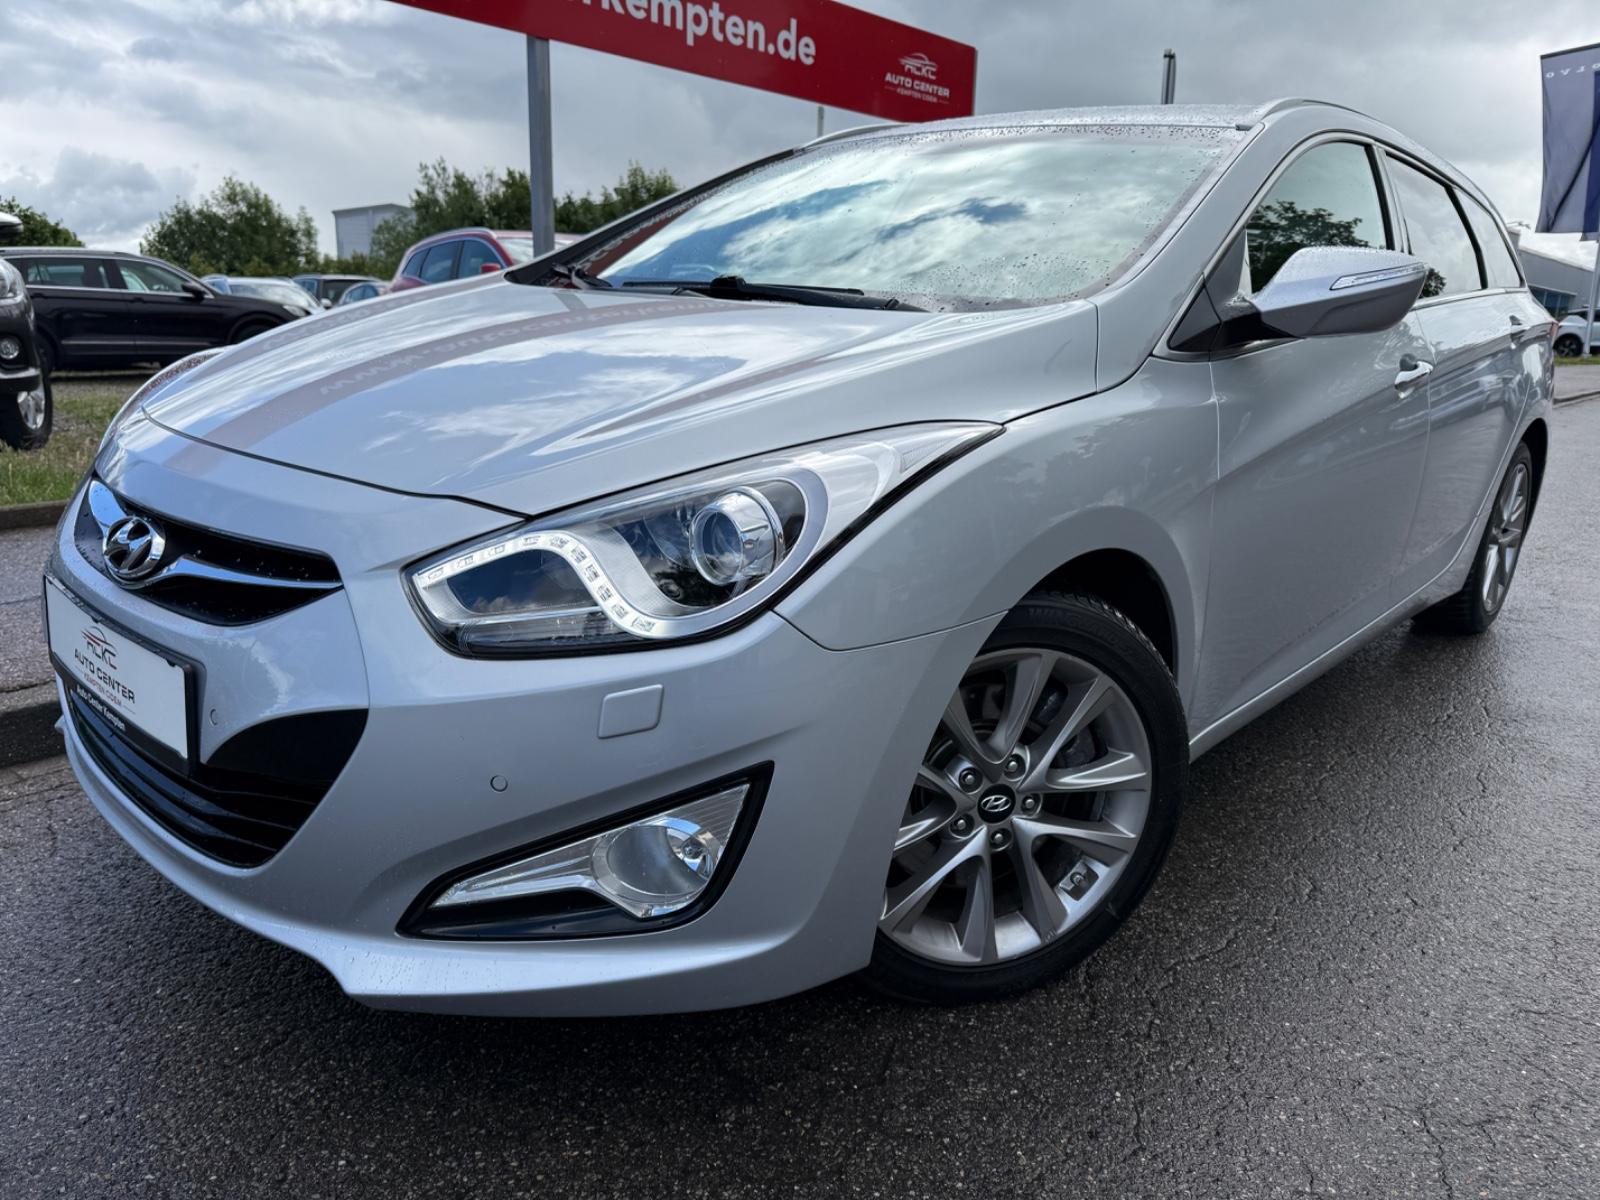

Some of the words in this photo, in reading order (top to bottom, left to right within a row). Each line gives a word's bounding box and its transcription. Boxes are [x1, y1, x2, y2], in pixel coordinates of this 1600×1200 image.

[884, 72, 912, 88] AUTO
[913, 80, 950, 98] CENTER
[75, 648, 95, 674] AUTO
[96, 667, 135, 704] CENTER
